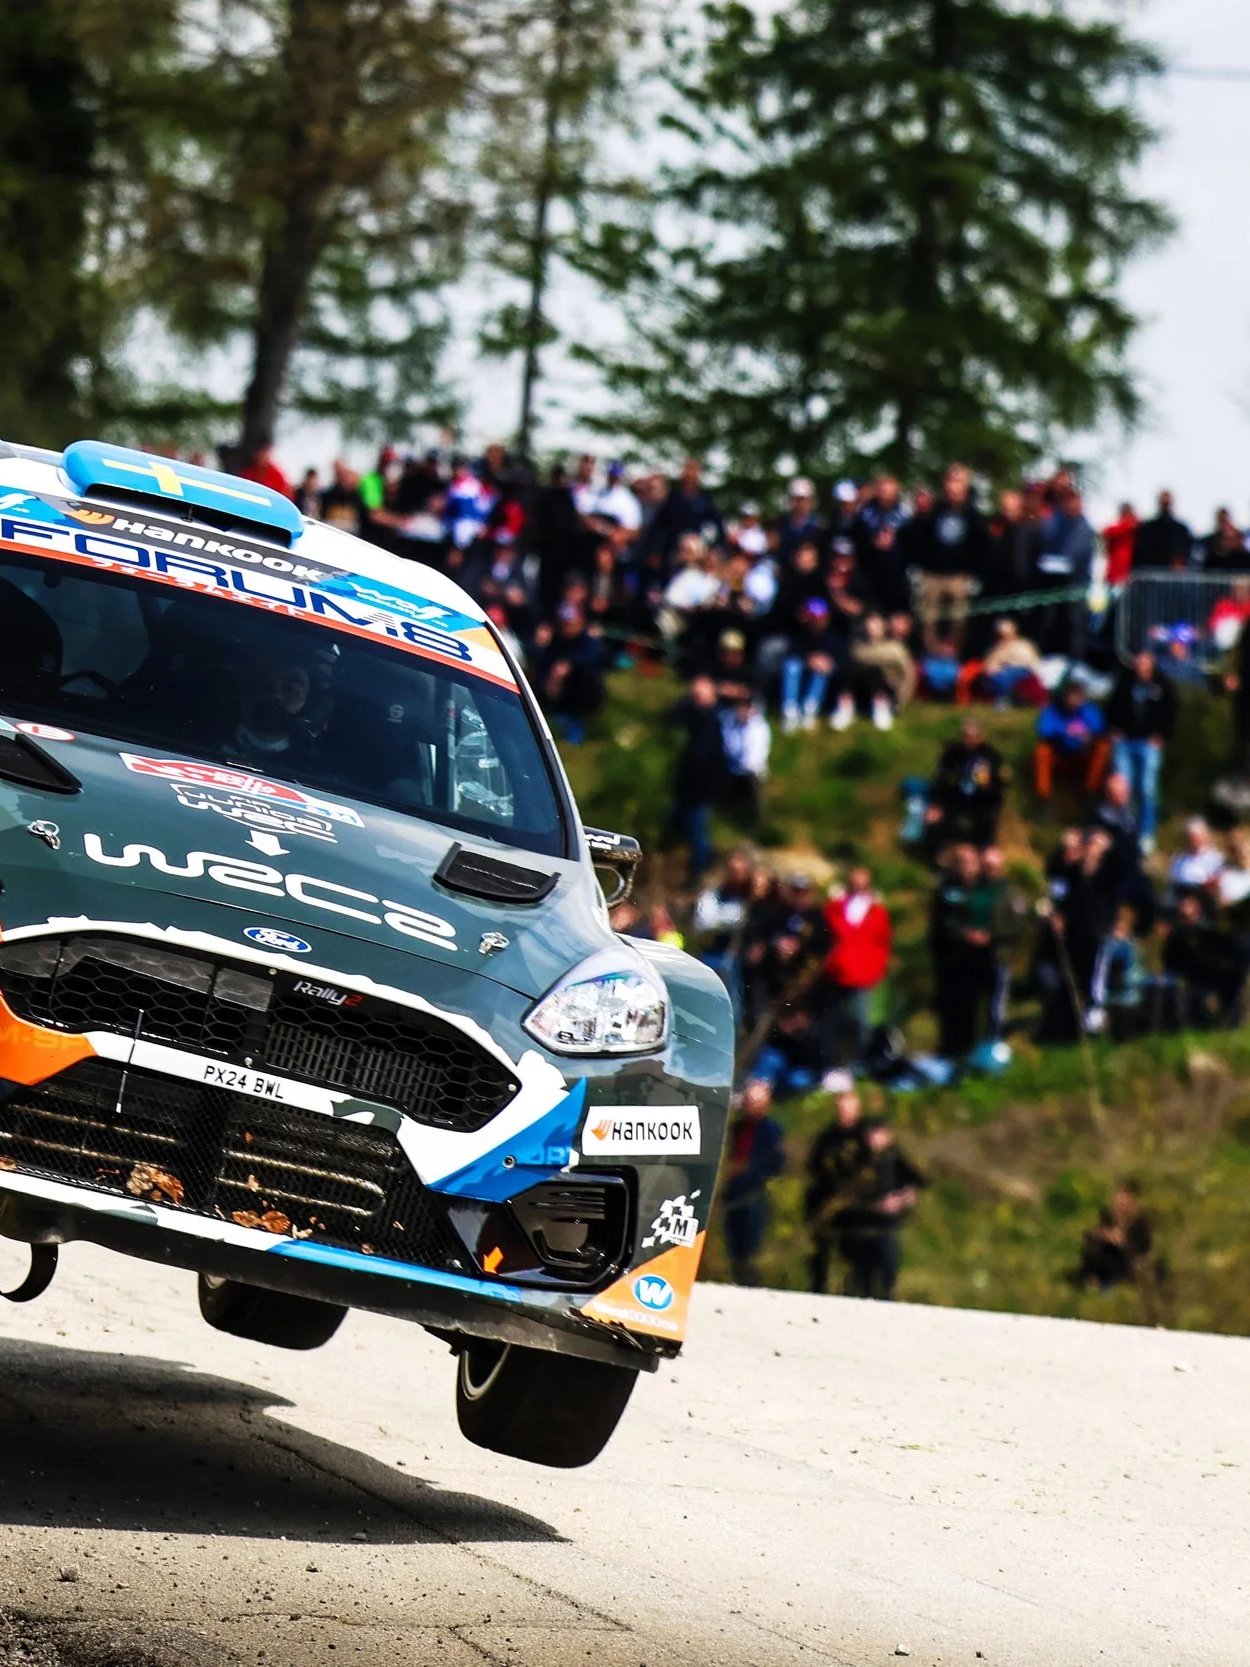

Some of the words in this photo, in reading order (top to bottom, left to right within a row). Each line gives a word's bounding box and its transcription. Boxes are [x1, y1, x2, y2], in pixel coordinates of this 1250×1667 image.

[0, 517, 473, 662] FORUM8
[83, 832, 458, 951] WRC2
[254, 928, 302, 951] Ford
[293, 980, 364, 1007] Rally2
[203, 1064, 247, 1089] PX24
[253, 1077, 284, 1100] BWL
[672, 1217, 689, 1237] M
